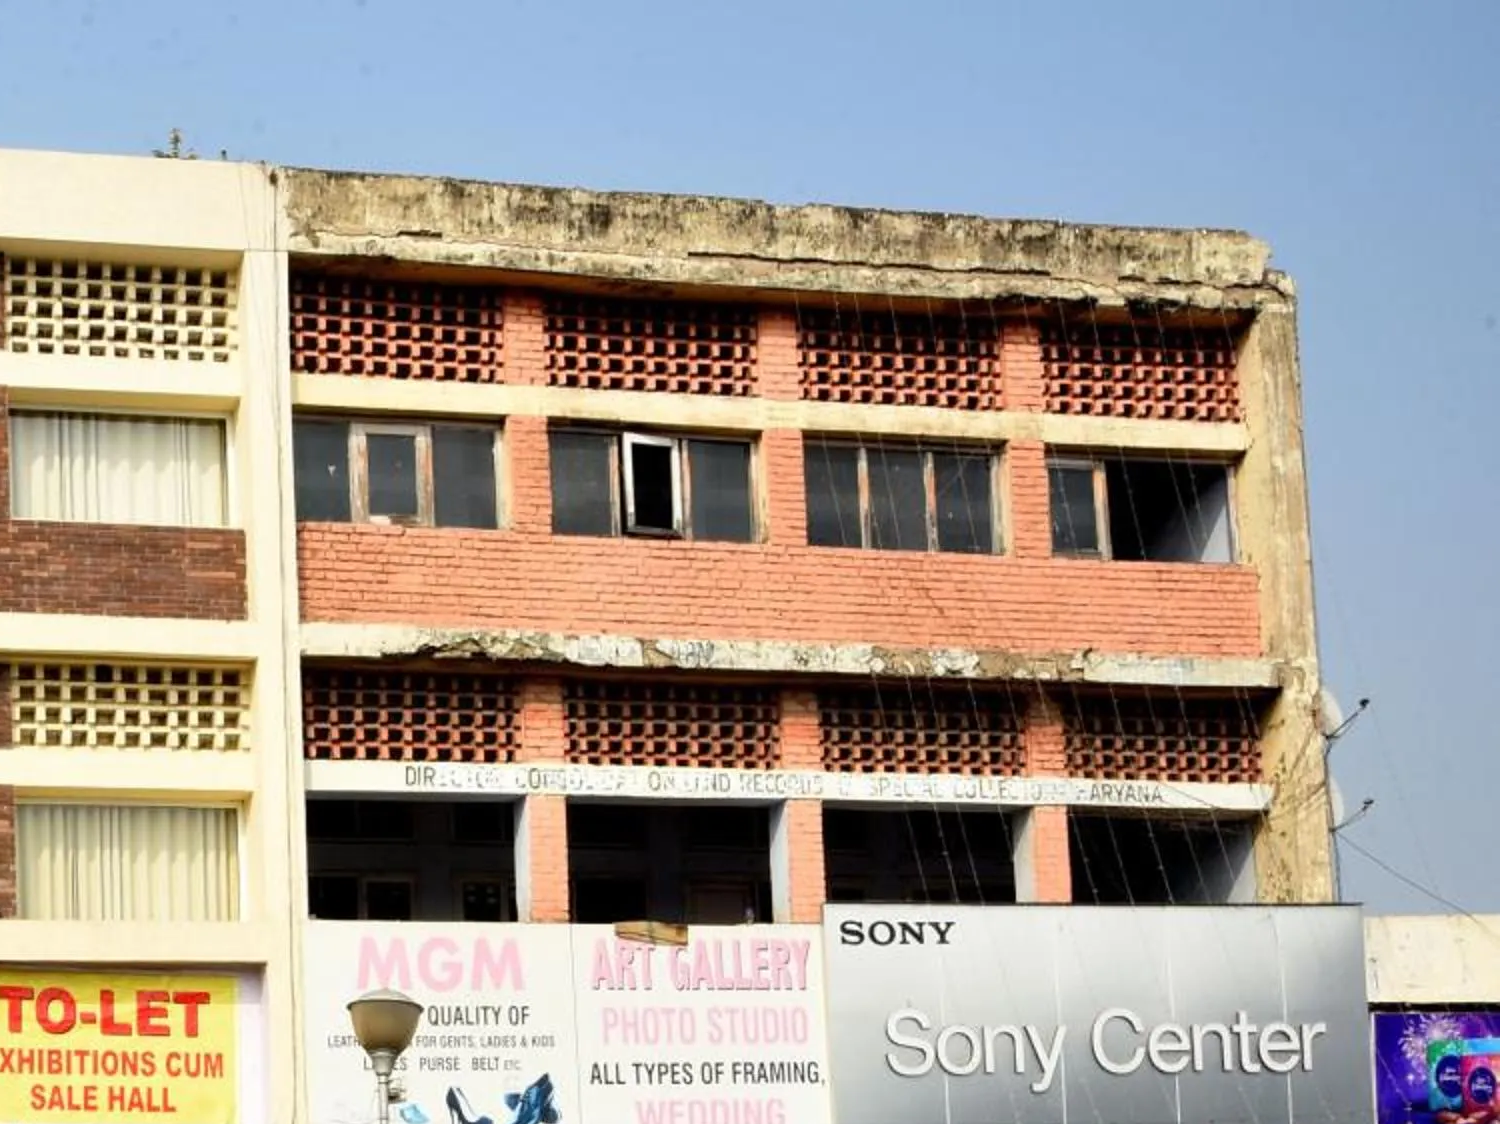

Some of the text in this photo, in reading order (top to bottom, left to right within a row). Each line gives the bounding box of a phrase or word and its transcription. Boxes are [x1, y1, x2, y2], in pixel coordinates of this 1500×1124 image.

[840, 920, 956, 945] SONY
[357, 936, 526, 992] MGM
[592, 938, 811, 991] ART GALLERY
[427, 1005, 531, 1026] QUALITY OF
[602, 1006, 809, 1045] PHOTO STUDIO
[416, 1036, 436, 1048] FOR
[480, 1035, 517, 1049] LADIES
[520, 1035, 528, 1048] &
[531, 1034, 556, 1048] KIDS
[885, 1008, 1328, 1095] Sony Center
[165, 1052, 224, 1079] CUM
[419, 1057, 460, 1071] PURSE
[471, 1057, 500, 1071] BELT
[590, 1061, 826, 1087] ALL TYPES OF FRAMING,
[30, 1084, 177, 1113] SALE HALL
